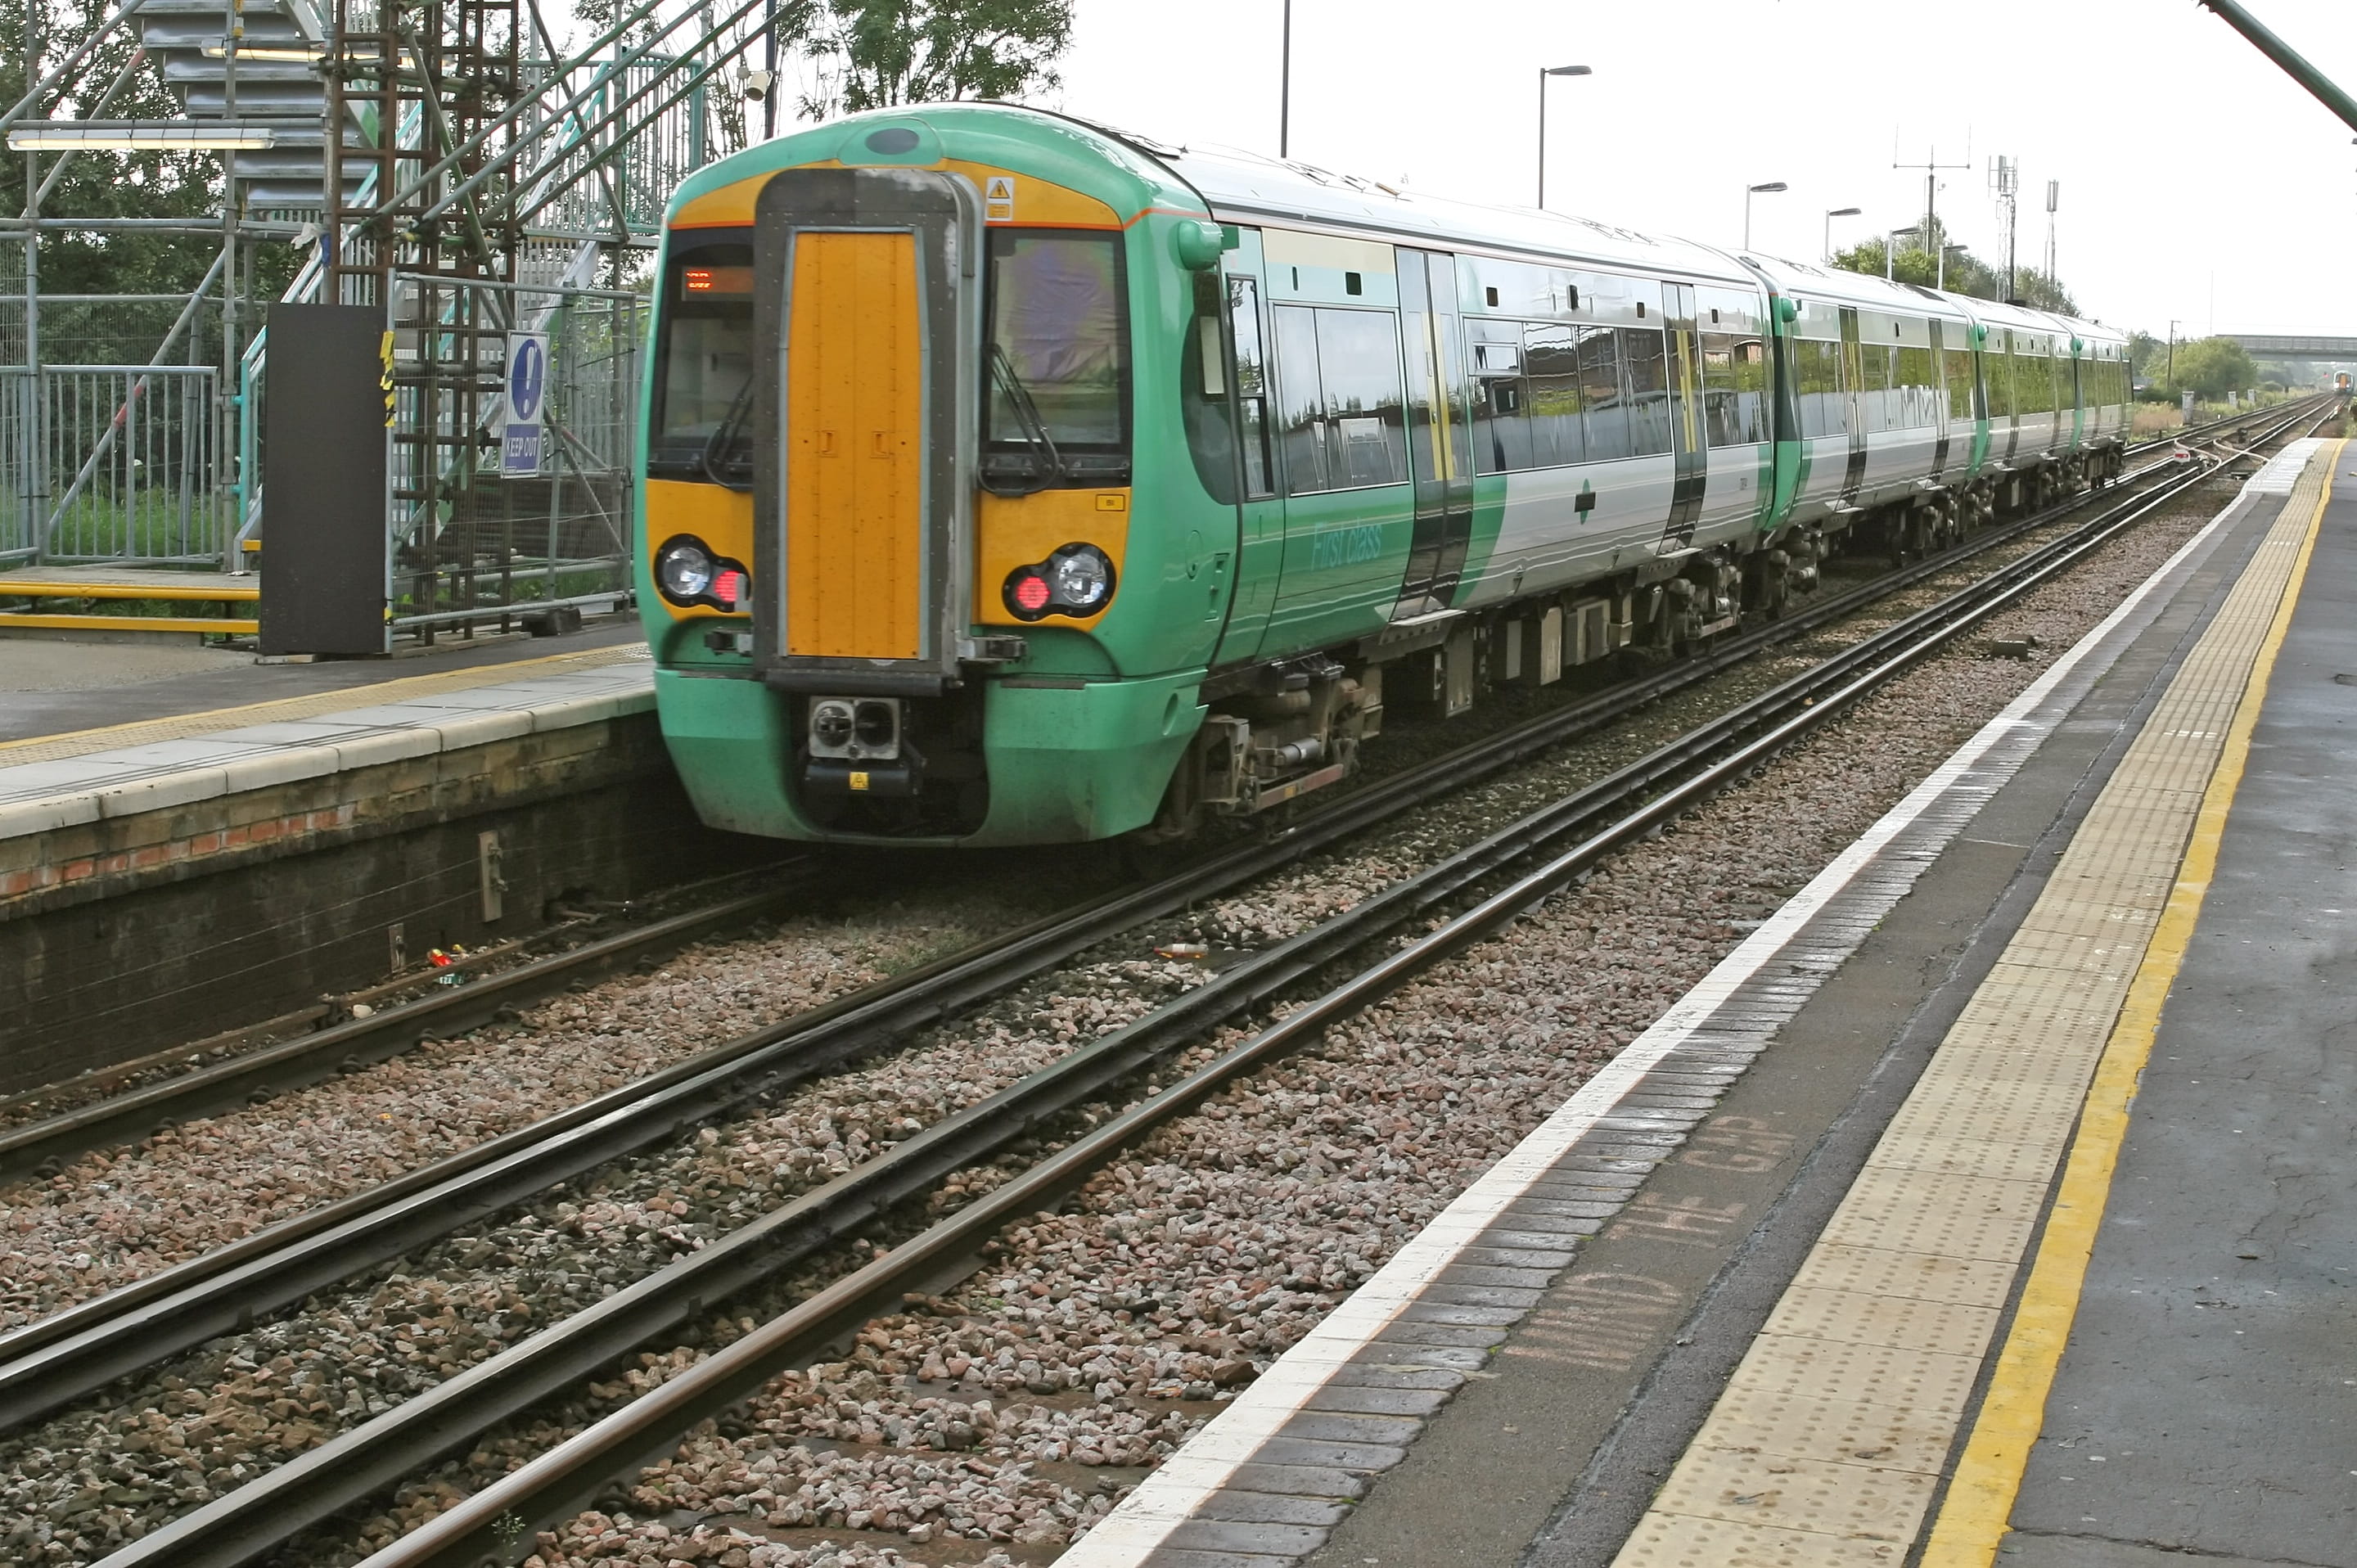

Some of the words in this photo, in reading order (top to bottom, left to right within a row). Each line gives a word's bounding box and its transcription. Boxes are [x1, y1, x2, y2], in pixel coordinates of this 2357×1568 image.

[507, 436, 524, 457] KEEP
[524, 436, 538, 457] OUT
[1310, 522, 1344, 571] First
[1347, 516, 1381, 563] class
[1503, 1271, 1683, 1371] MIND
[1603, 1192, 1747, 1249] THE
[1679, 1115, 1796, 1173] GAP
